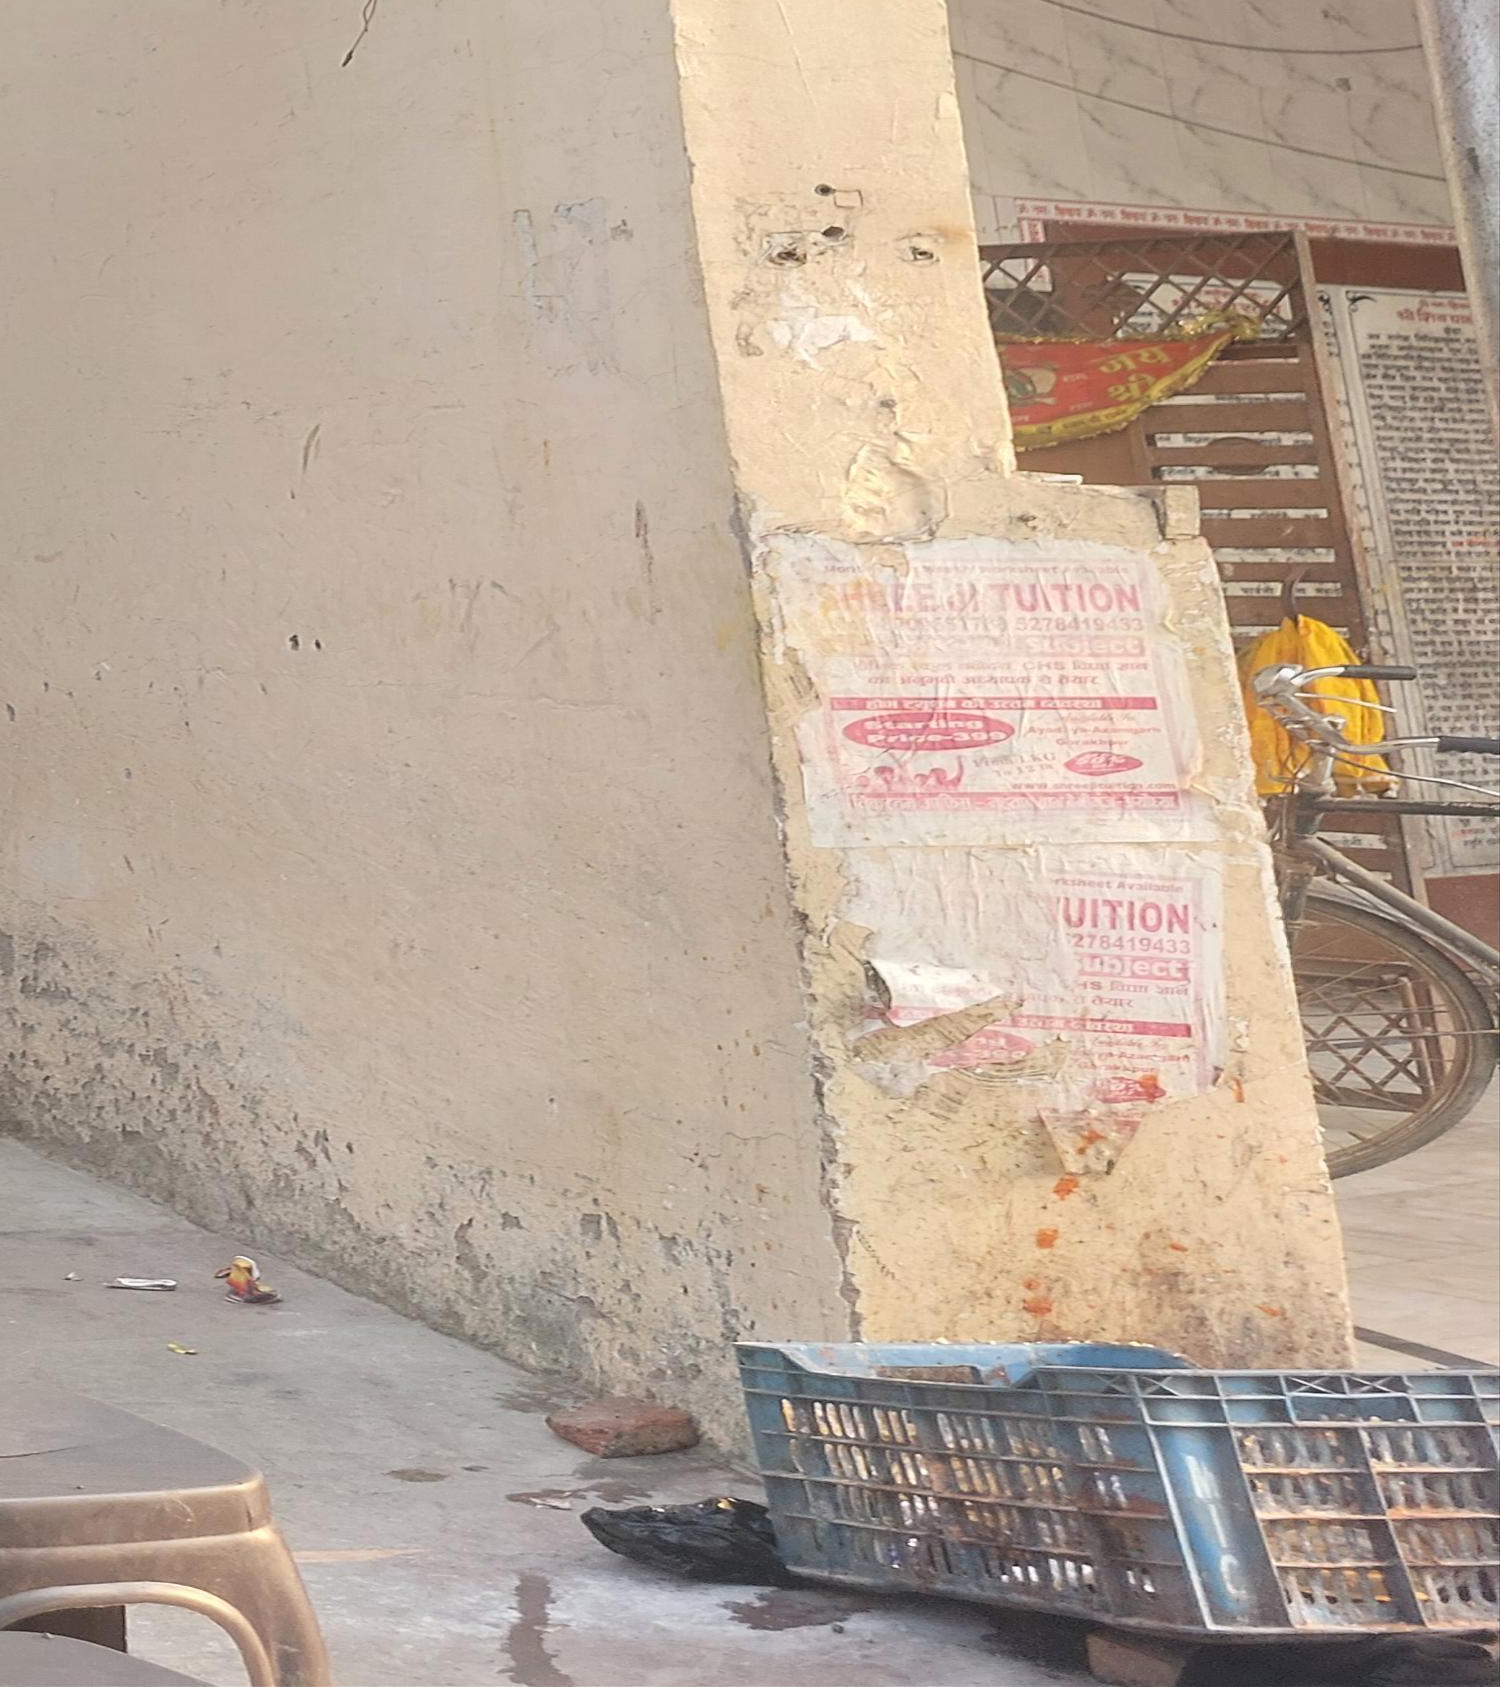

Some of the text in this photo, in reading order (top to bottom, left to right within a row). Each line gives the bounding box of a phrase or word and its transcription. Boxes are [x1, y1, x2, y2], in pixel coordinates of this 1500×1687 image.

[991, 582, 1140, 614] TUITION
[862, 718, 984, 732] Starting
[1055, 877, 1184, 895] rksheet Available
[1058, 897, 1189, 934] UITION
